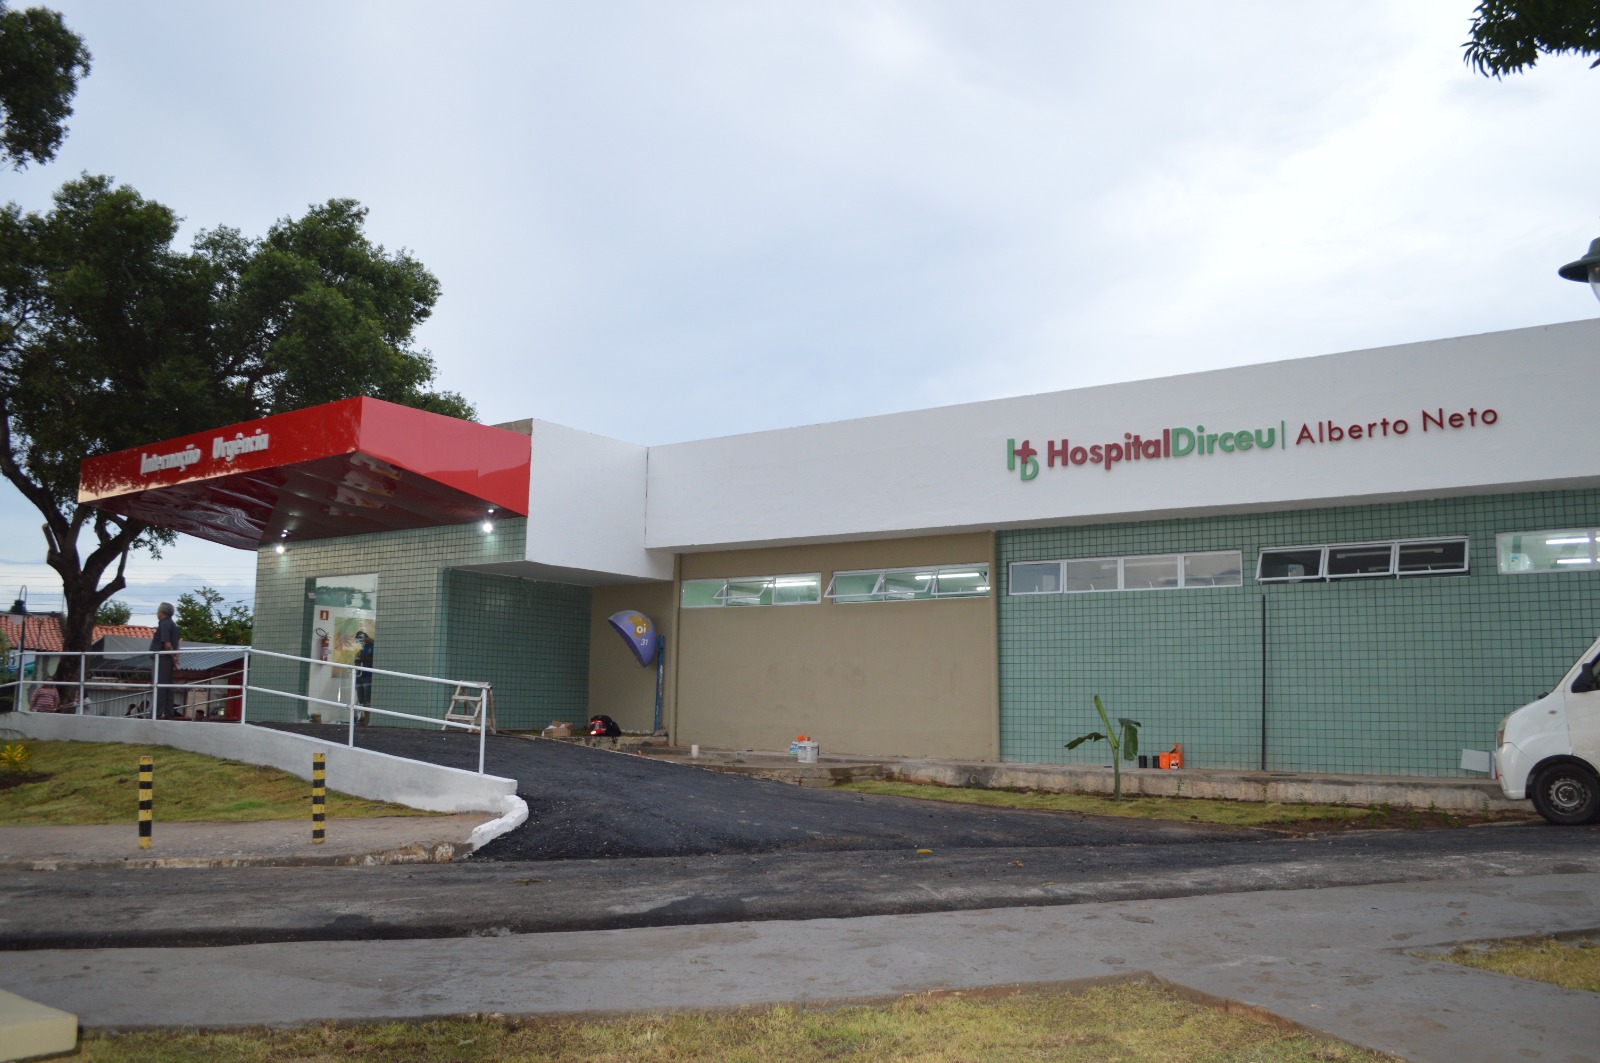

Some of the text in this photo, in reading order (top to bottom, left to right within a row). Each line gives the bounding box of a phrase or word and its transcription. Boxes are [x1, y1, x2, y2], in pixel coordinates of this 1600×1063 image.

[1295, 418, 1409, 445] Alberto
[1422, 407, 1498, 432] Neto
[140, 429, 269, 476] Internação Urgência
